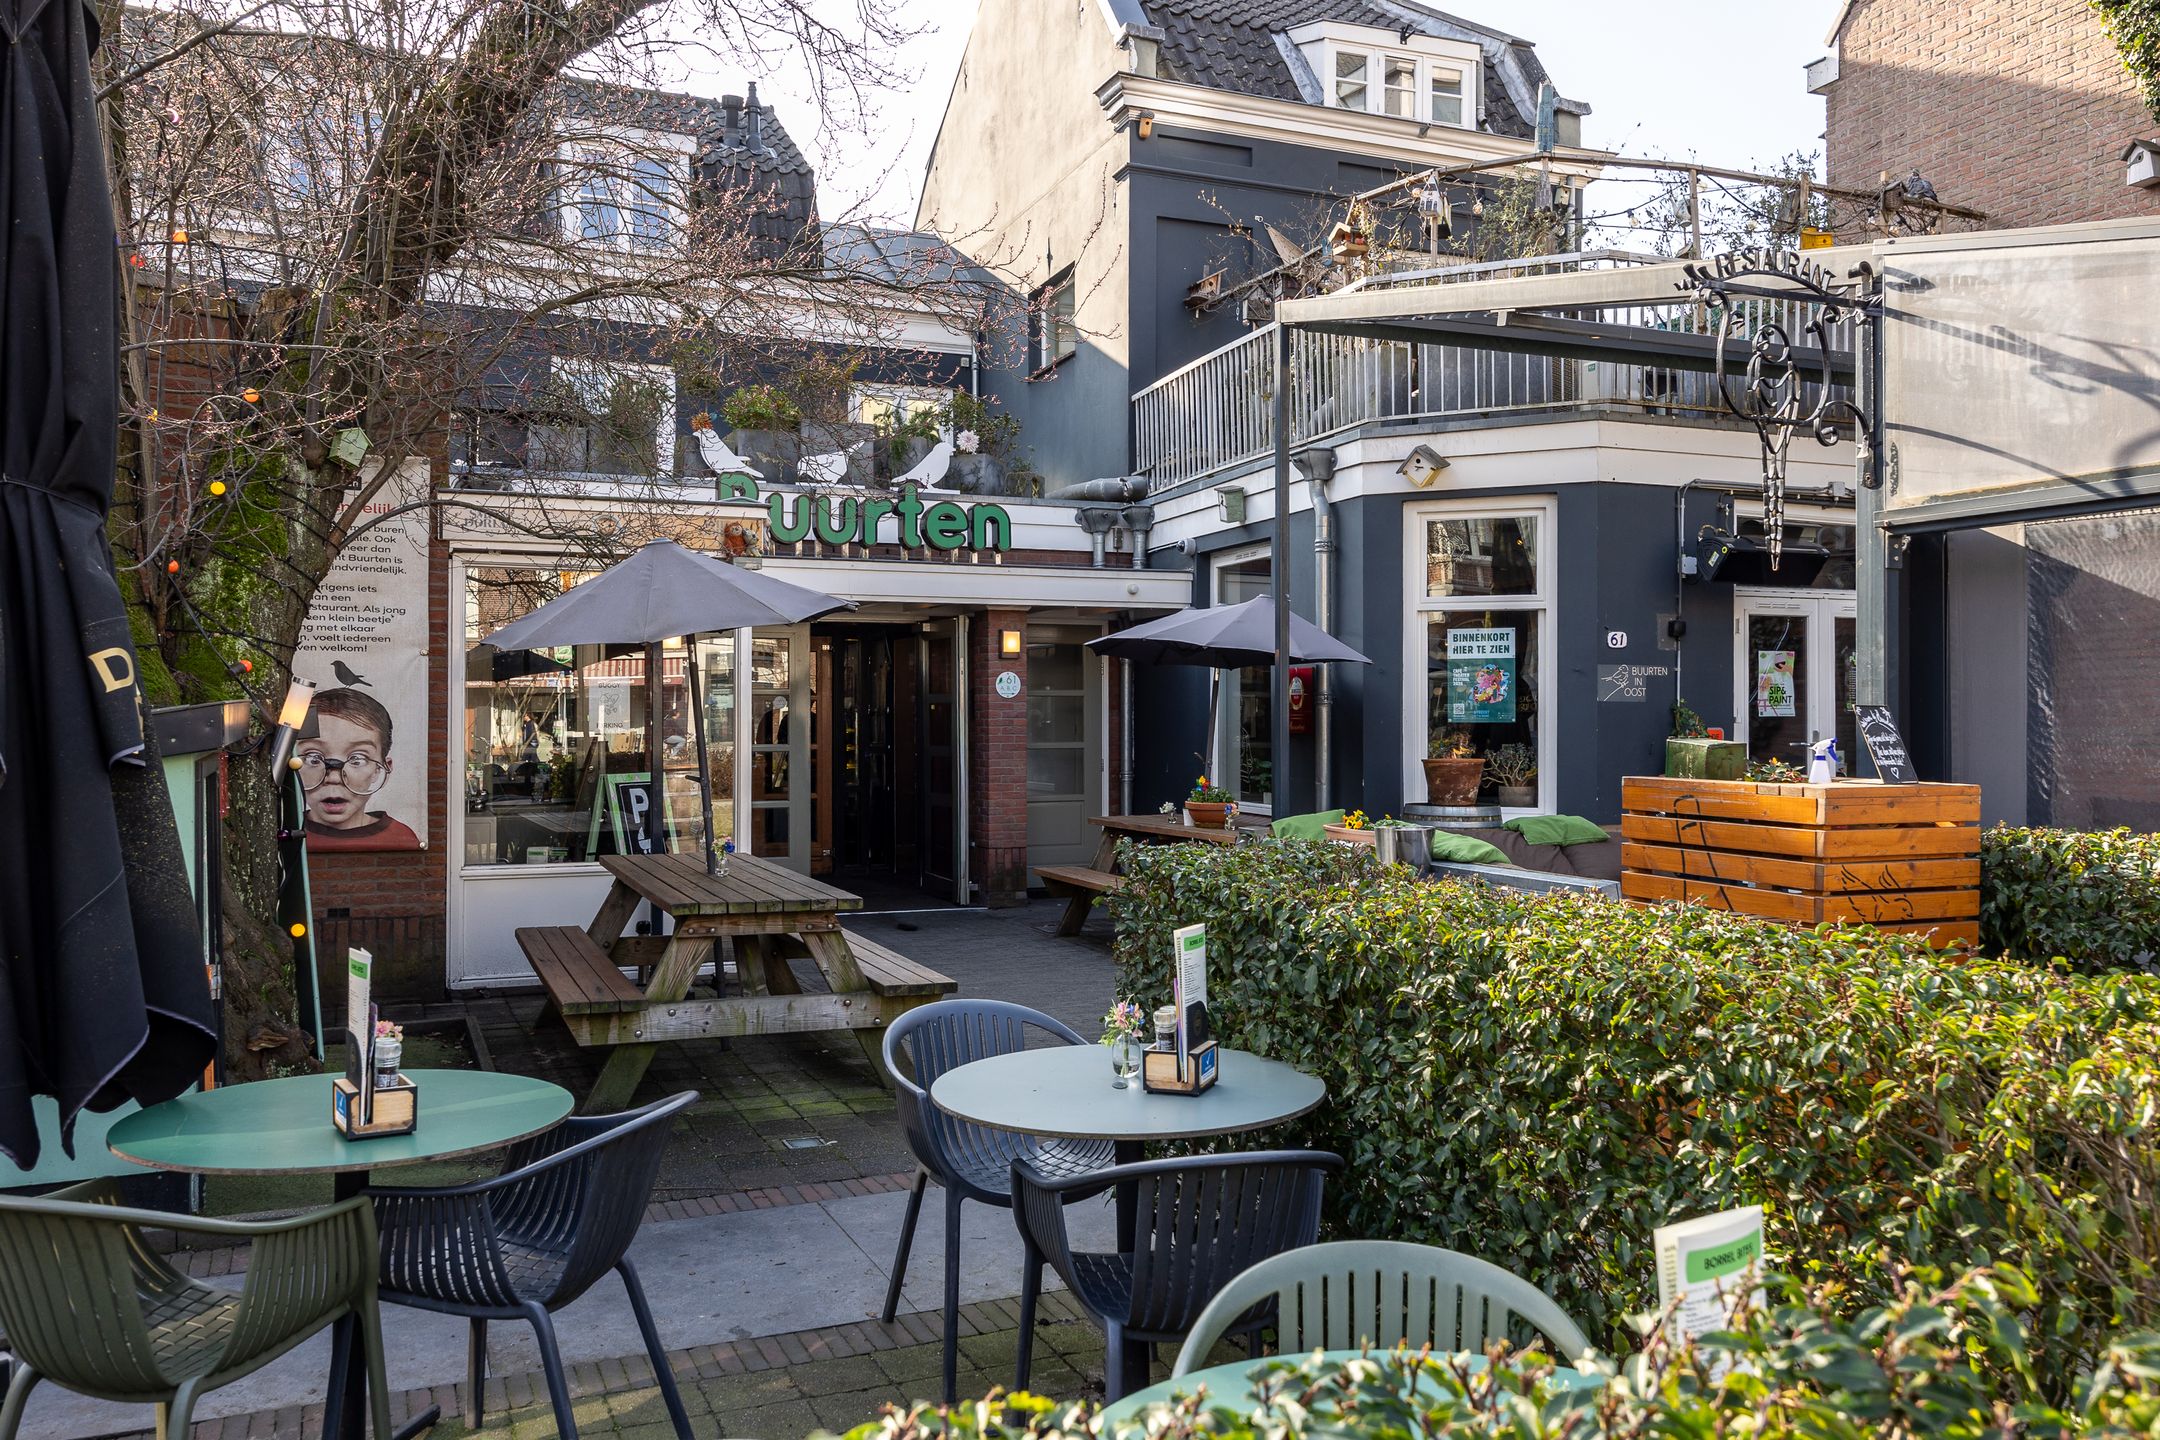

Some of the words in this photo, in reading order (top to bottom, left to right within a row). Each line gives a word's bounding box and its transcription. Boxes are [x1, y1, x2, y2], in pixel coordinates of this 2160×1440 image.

[1714, 246, 1836, 295] RESTAURANT
[373, 526, 405, 534] buren
[374, 535, 397, 543] Ook
[370, 545, 391, 553] dan
[348, 554, 392, 563] Buurten
[394, 556, 403, 564] is
[357, 584, 377, 592] iets
[363, 605, 381, 613] Als
[382, 606, 406, 615] jong
[328, 614, 355, 622] klein
[340, 624, 376, 632] elkaar
[343, 634, 391, 643] iedereen
[1452, 632, 1510, 643] BINNENKORT
[1610, 633, 1624, 646] 61
[320, 644, 368, 652] welkom!
[1452, 645, 1474, 655] HIER
[1476, 645, 1487, 654] TE
[1489, 644, 1510, 654] ZIEN
[1631, 666, 1668, 676] BUURTEN
[1006, 675, 1017, 685] 61
[1634, 678, 1643, 686] IN
[1624, 687, 1646, 697] OOST
[1769, 686, 1786, 695] SIP&
[1768, 695, 1792, 704] PAINT
[1703, 1250, 1736, 1270] BORREL
